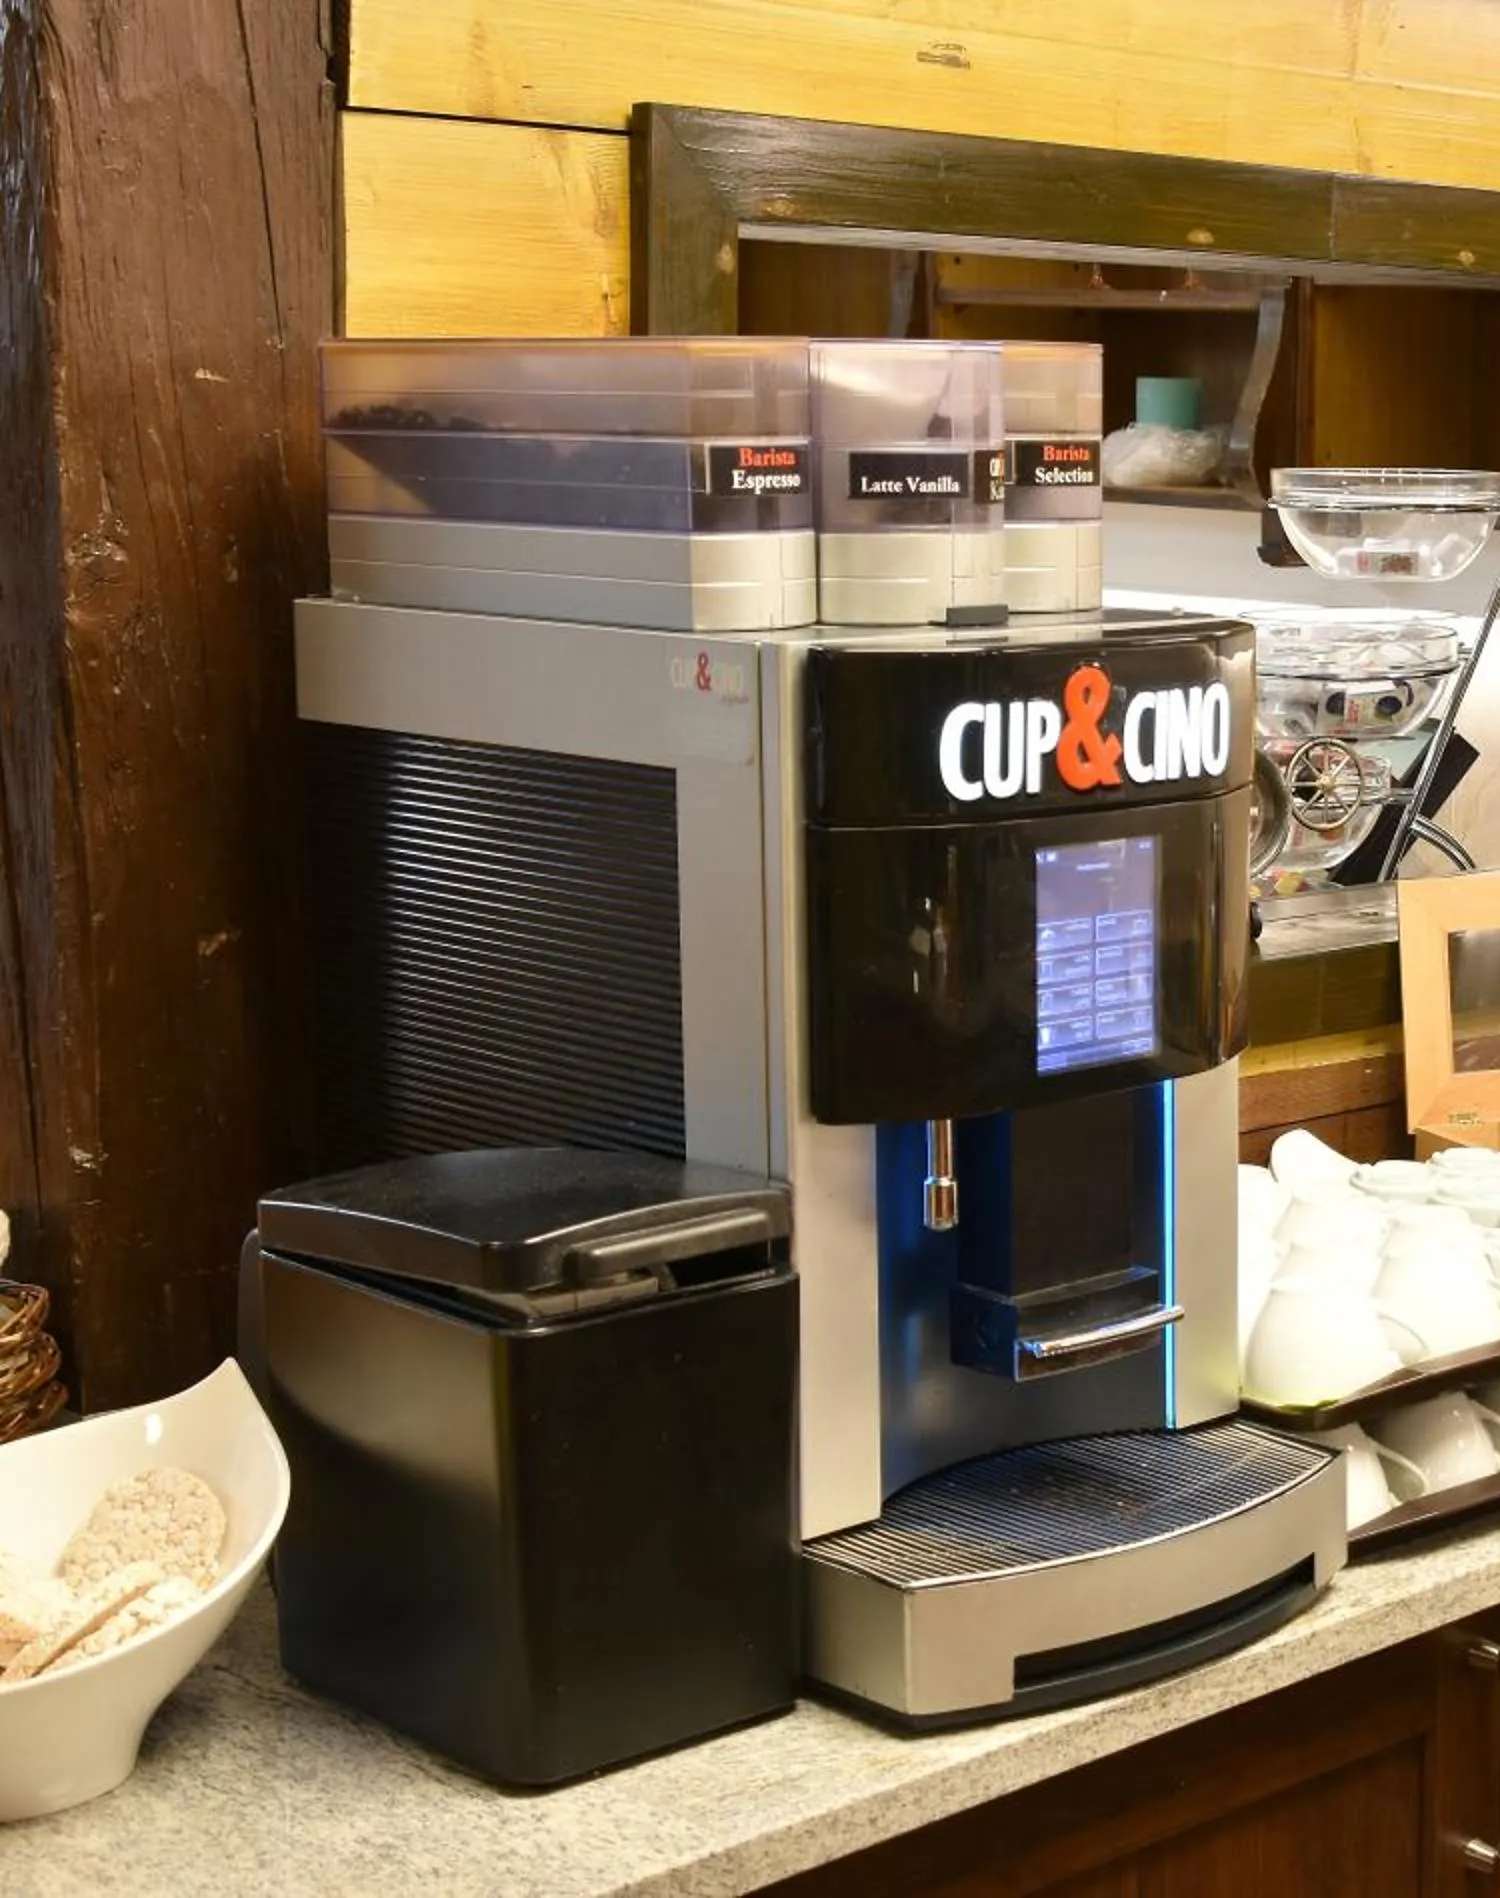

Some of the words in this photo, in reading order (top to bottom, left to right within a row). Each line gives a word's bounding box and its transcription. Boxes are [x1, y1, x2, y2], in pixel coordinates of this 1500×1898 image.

[739, 447, 797, 467] Barista
[1043, 444, 1089, 461] Barista
[731, 469, 801, 495] Espresso
[860, 476, 903, 493] Latte
[906, 476, 961, 493] Vanilla
